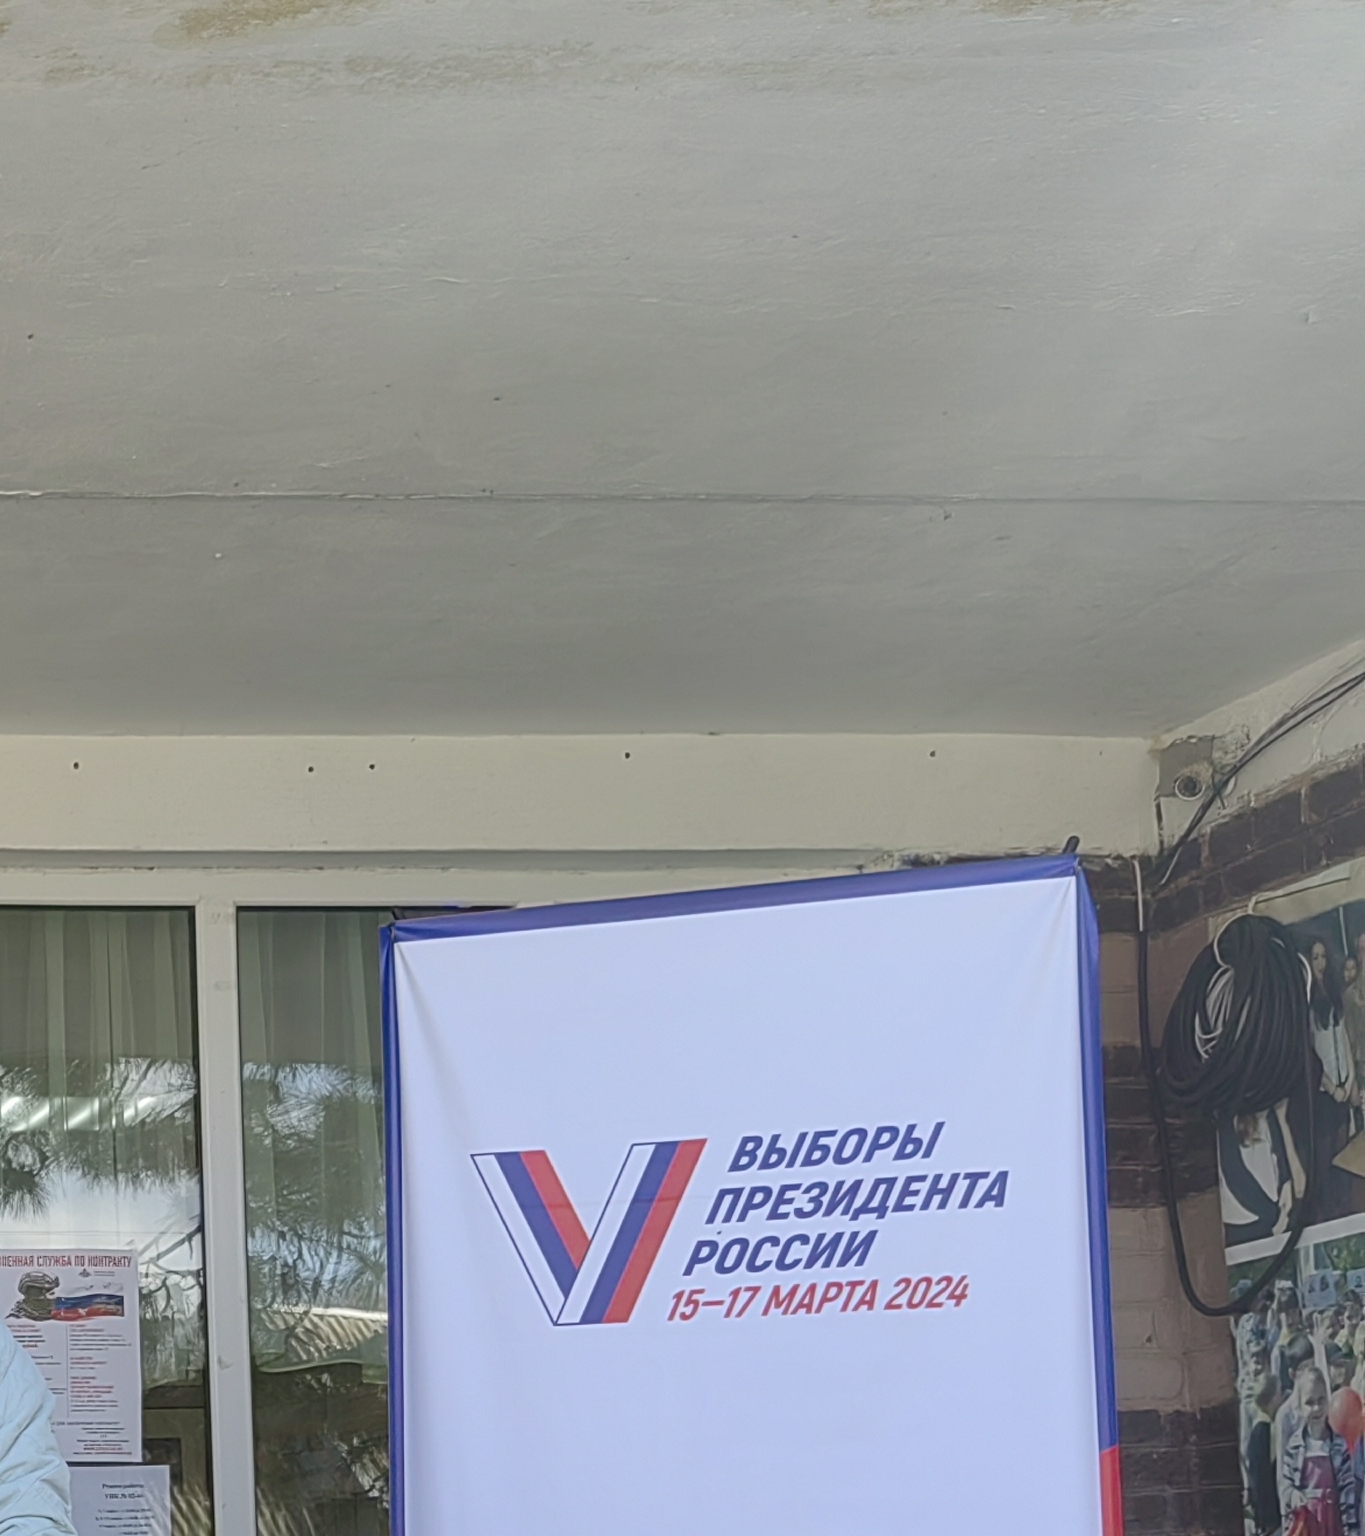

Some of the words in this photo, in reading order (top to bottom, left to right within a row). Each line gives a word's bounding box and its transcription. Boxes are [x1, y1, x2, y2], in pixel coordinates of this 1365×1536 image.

[727, 1121, 945, 1173] ВЫБОРЫ
[705, 1170, 1009, 1225] ПРЕЗИДЕНТА
[36, 1255, 72, 1268] СЛУЖБА
[682, 1229, 878, 1277] РОССИИ
[667, 1285, 761, 1323] 15–17
[761, 1278, 879, 1318] МАРТА
[883, 1274, 970, 1312] 2024
